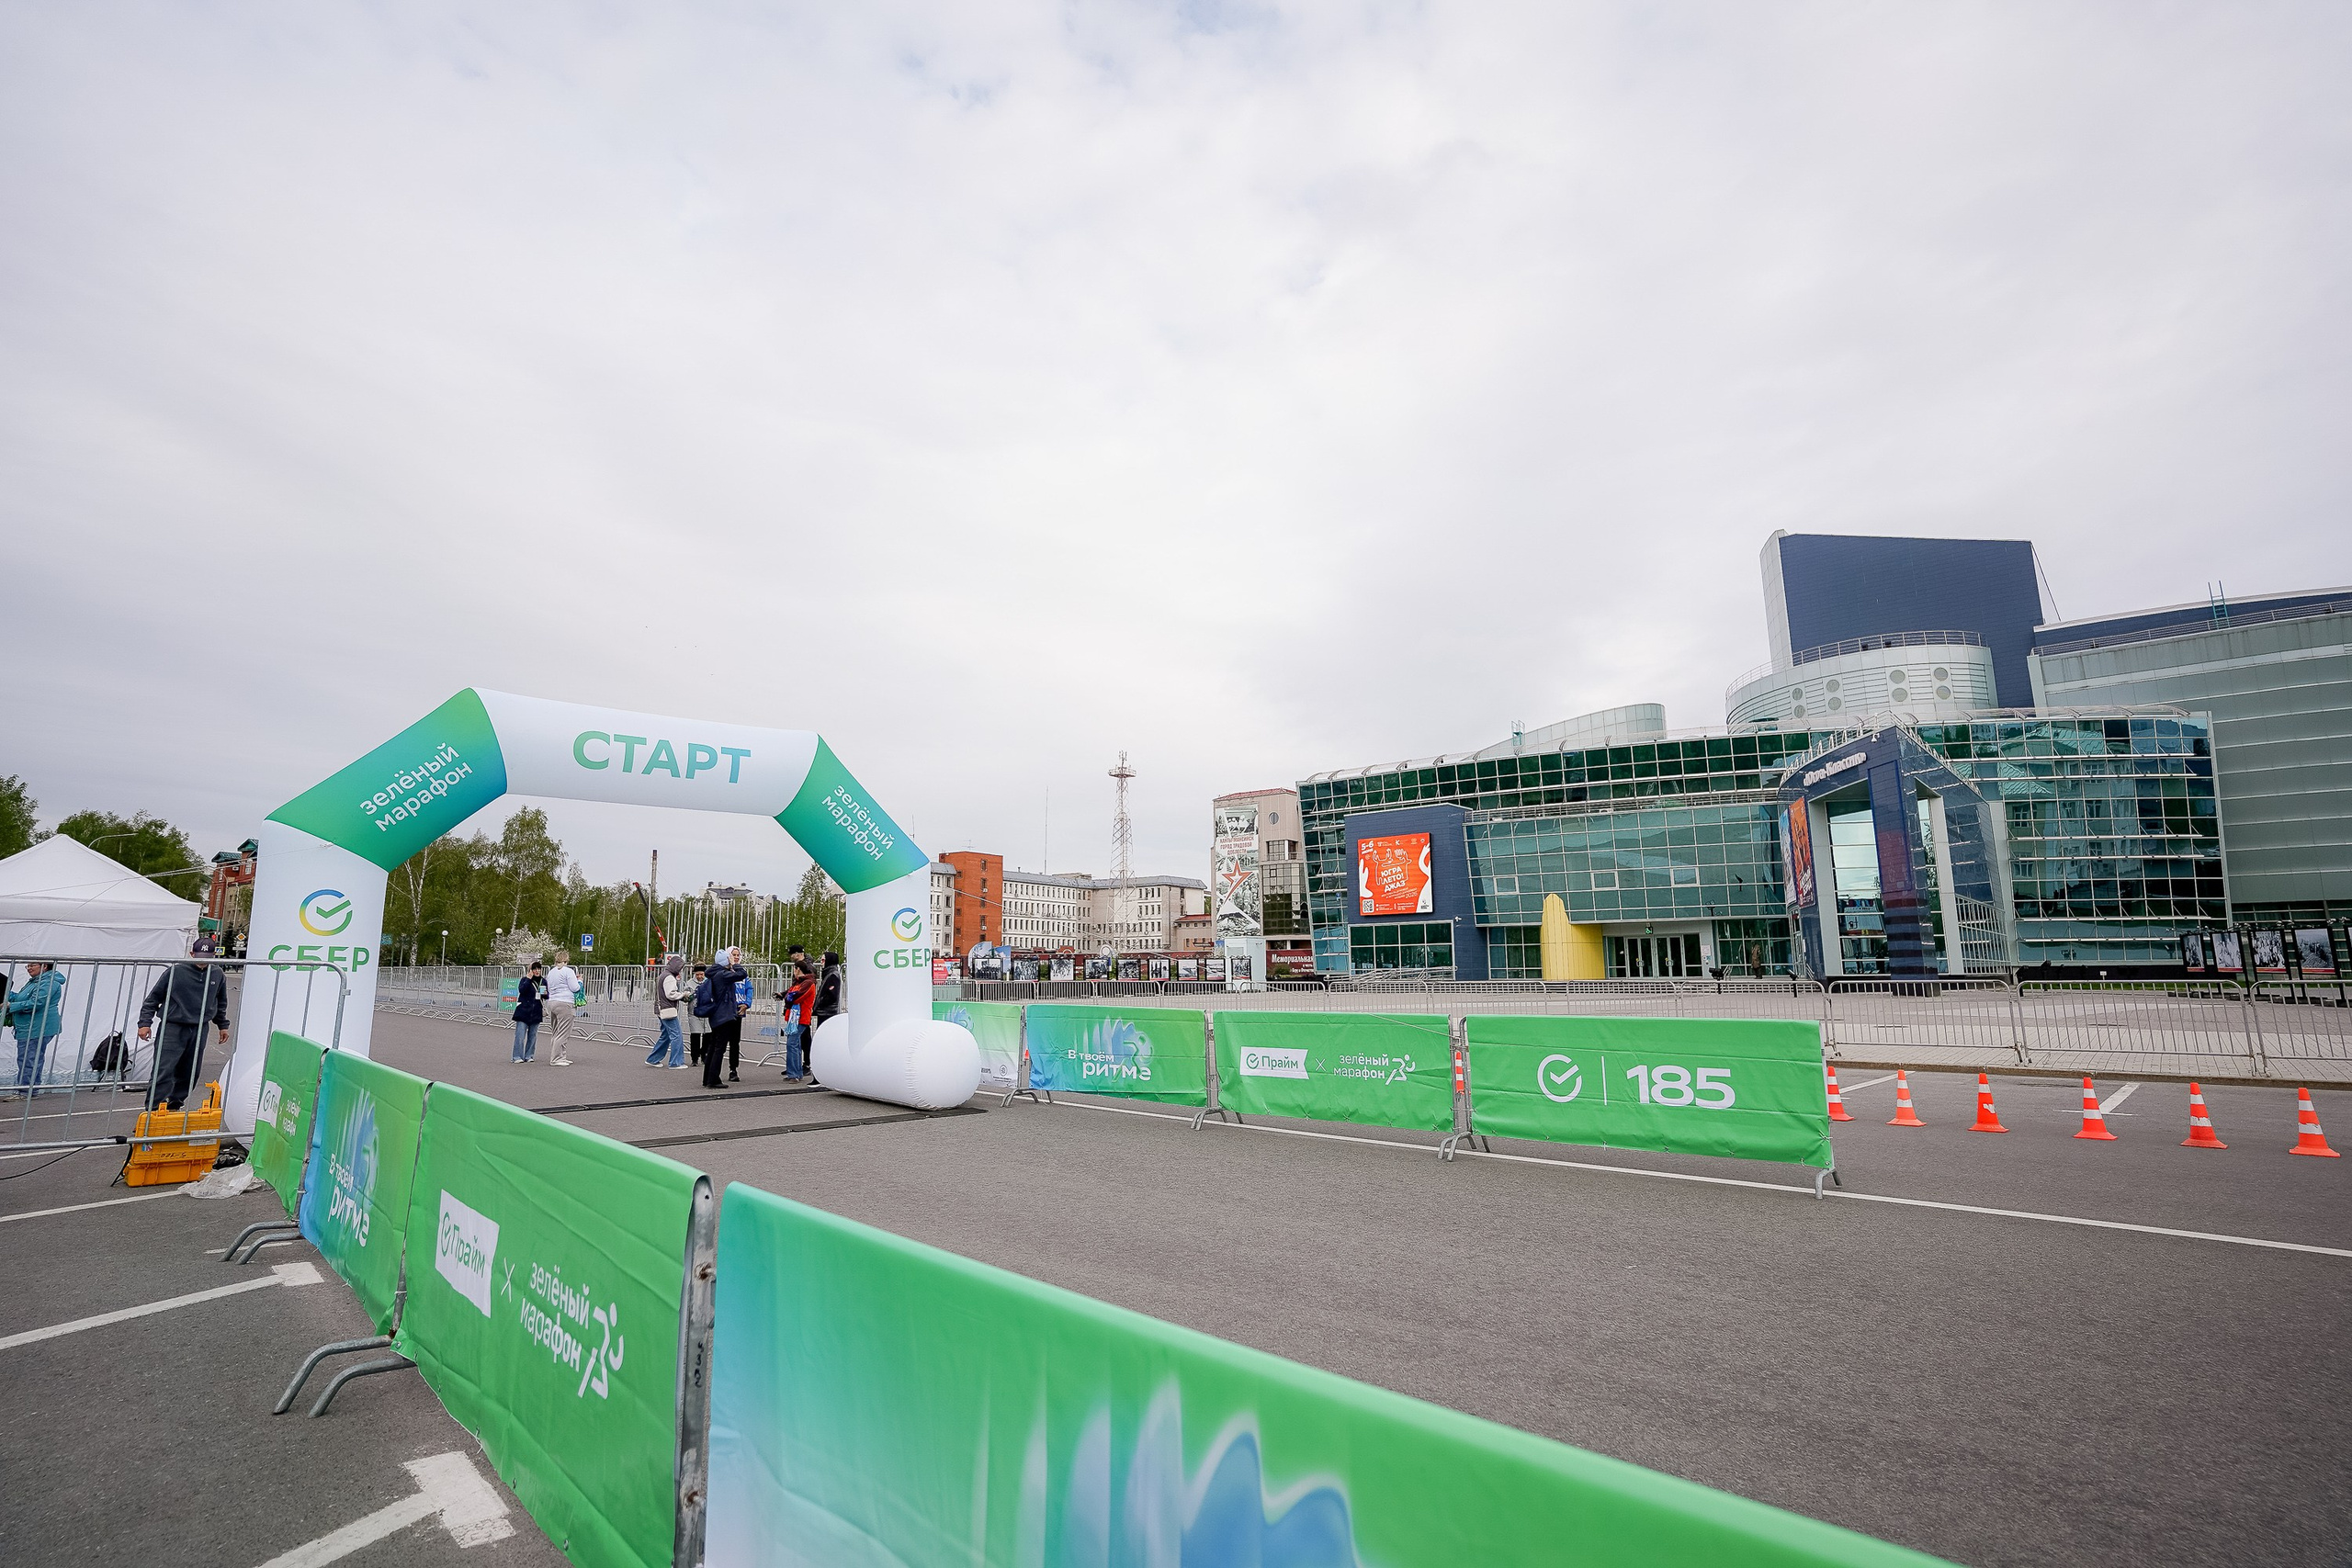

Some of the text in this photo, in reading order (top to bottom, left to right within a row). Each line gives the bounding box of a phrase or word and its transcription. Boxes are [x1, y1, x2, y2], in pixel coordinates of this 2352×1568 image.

[573, 730, 752, 784] СТАРТ
[359, 742, 460, 816] зелёный
[374, 761, 473, 832] марафон
[821, 795, 884, 861] марафон
[833, 784, 895, 850] зелёный
[1361, 840, 1374, 851] 5-6
[1381, 866, 1403, 877] ЮГРА
[1384, 880, 1406, 893] ДЖАЗ
[584, 935, 592, 945] P
[267, 944, 370, 973] СБЕР
[873, 948, 931, 969] СБЕР
[1068, 1049, 1114, 1063] В твоём
[1082, 1062, 1152, 1081] ритме
[1261, 1055, 1299, 1070] Прайм
[1339, 1053, 1389, 1066] зелёный
[1333, 1066, 1385, 1081] марафон
[1626, 1065, 1736, 1109] 185
[329, 1153, 355, 1192] В твоём
[327, 1184, 370, 1247] ритме
[450, 1224, 486, 1279] Прайм
[529, 1261, 590, 1330] зелёный
[520, 1297, 582, 1373] марафон
